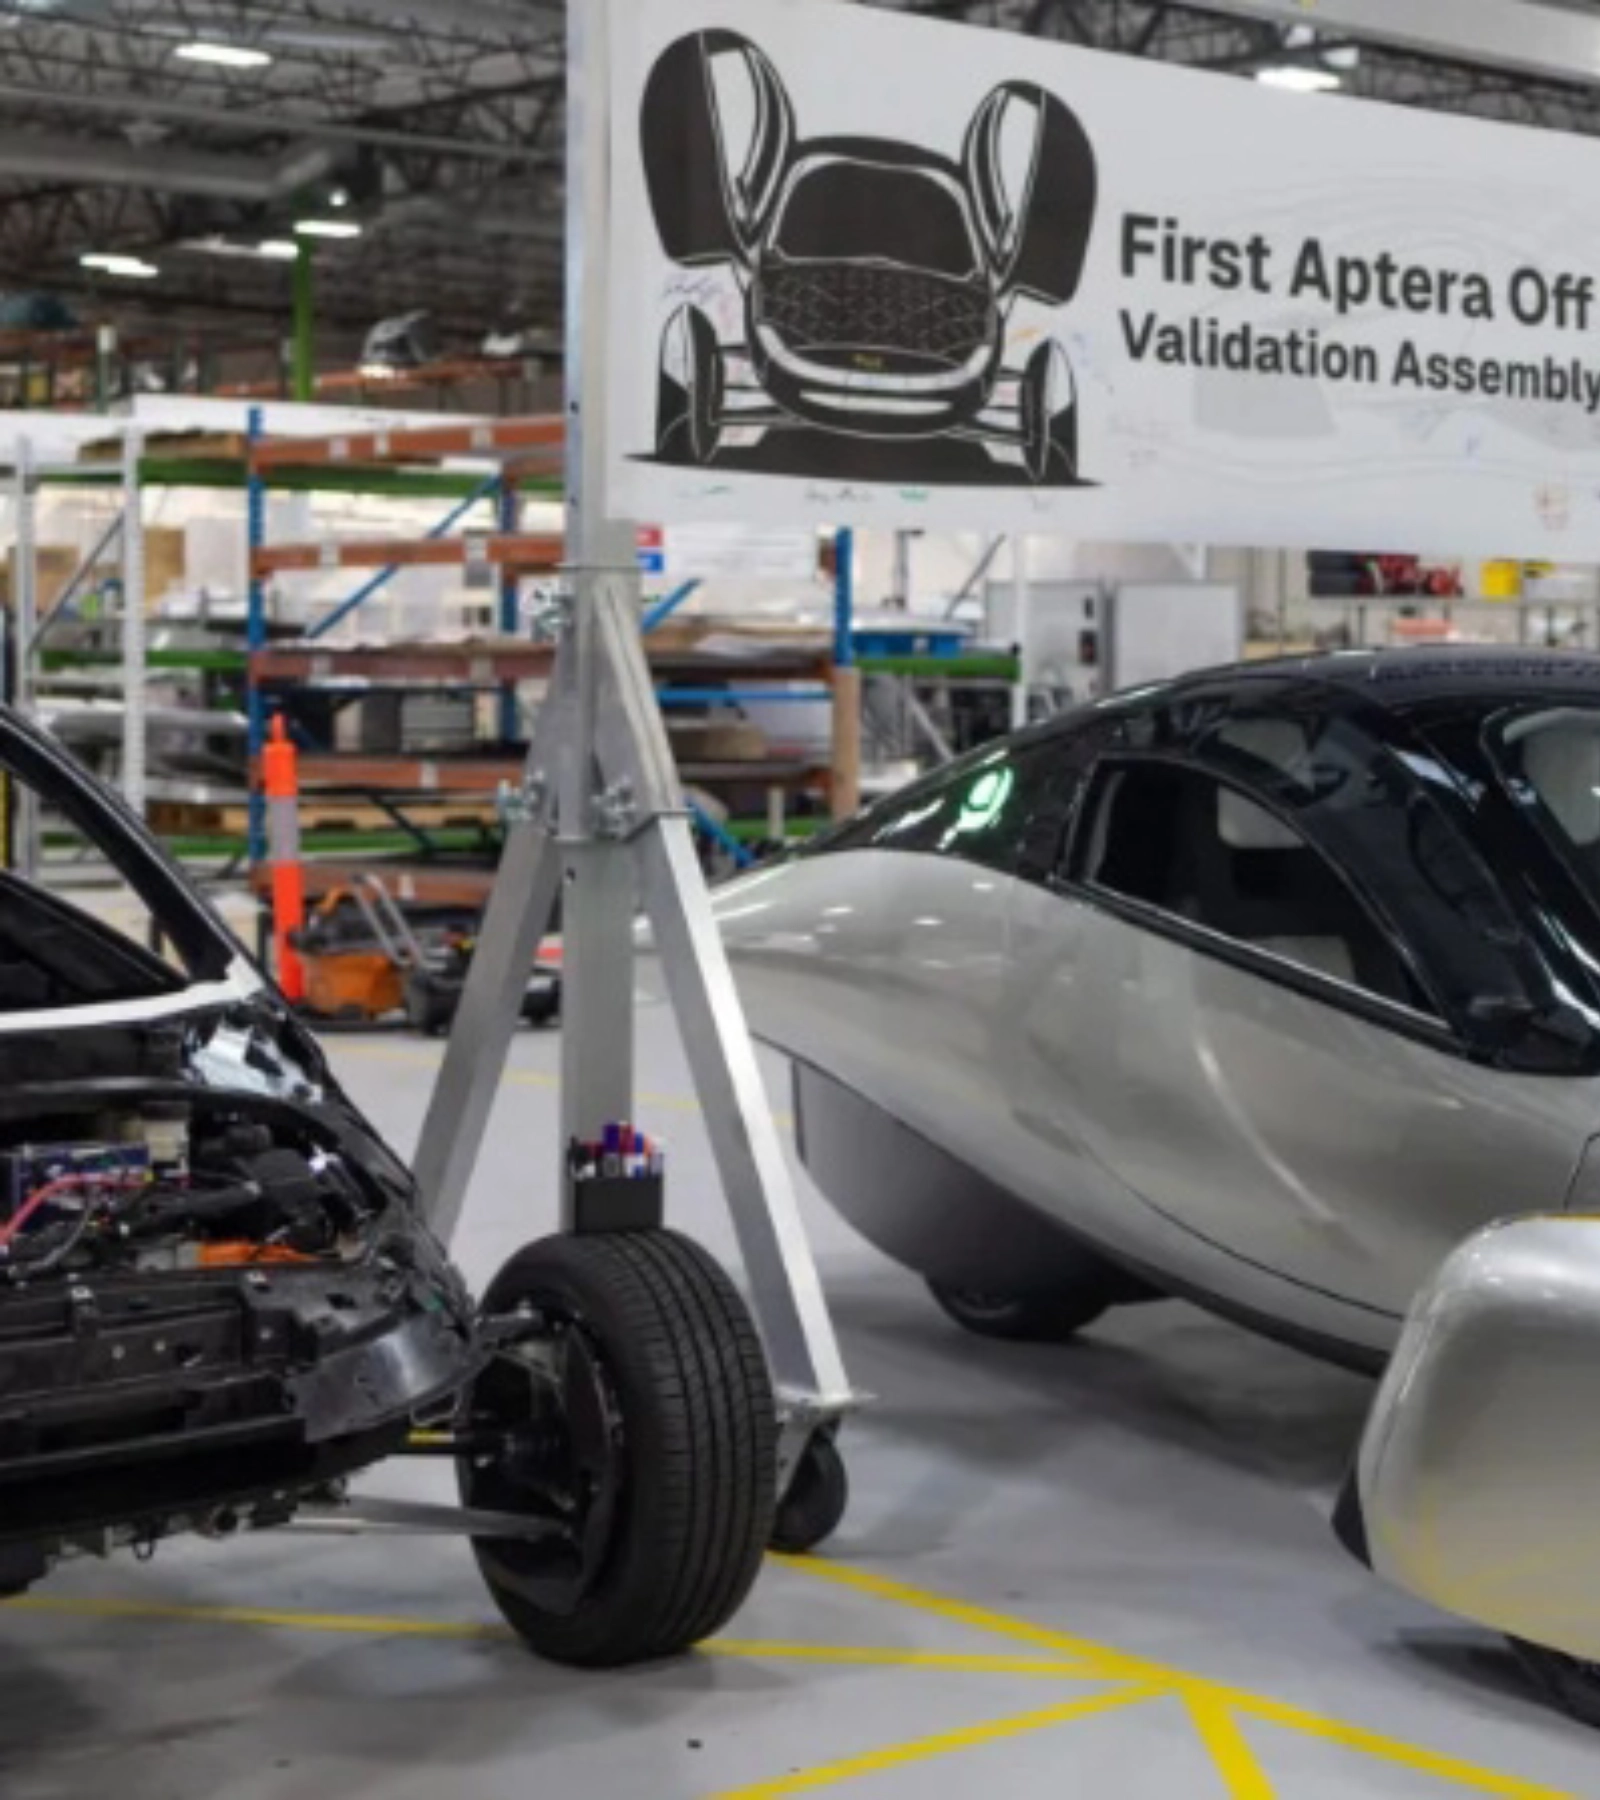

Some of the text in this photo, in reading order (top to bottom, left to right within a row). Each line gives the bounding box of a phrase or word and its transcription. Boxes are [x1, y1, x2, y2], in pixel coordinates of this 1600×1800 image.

[1120, 212, 1272, 294] First
[1289, 237, 1494, 316] Aptera
[1509, 266, 1594, 331] Off
[1119, 308, 1378, 383] Validation
